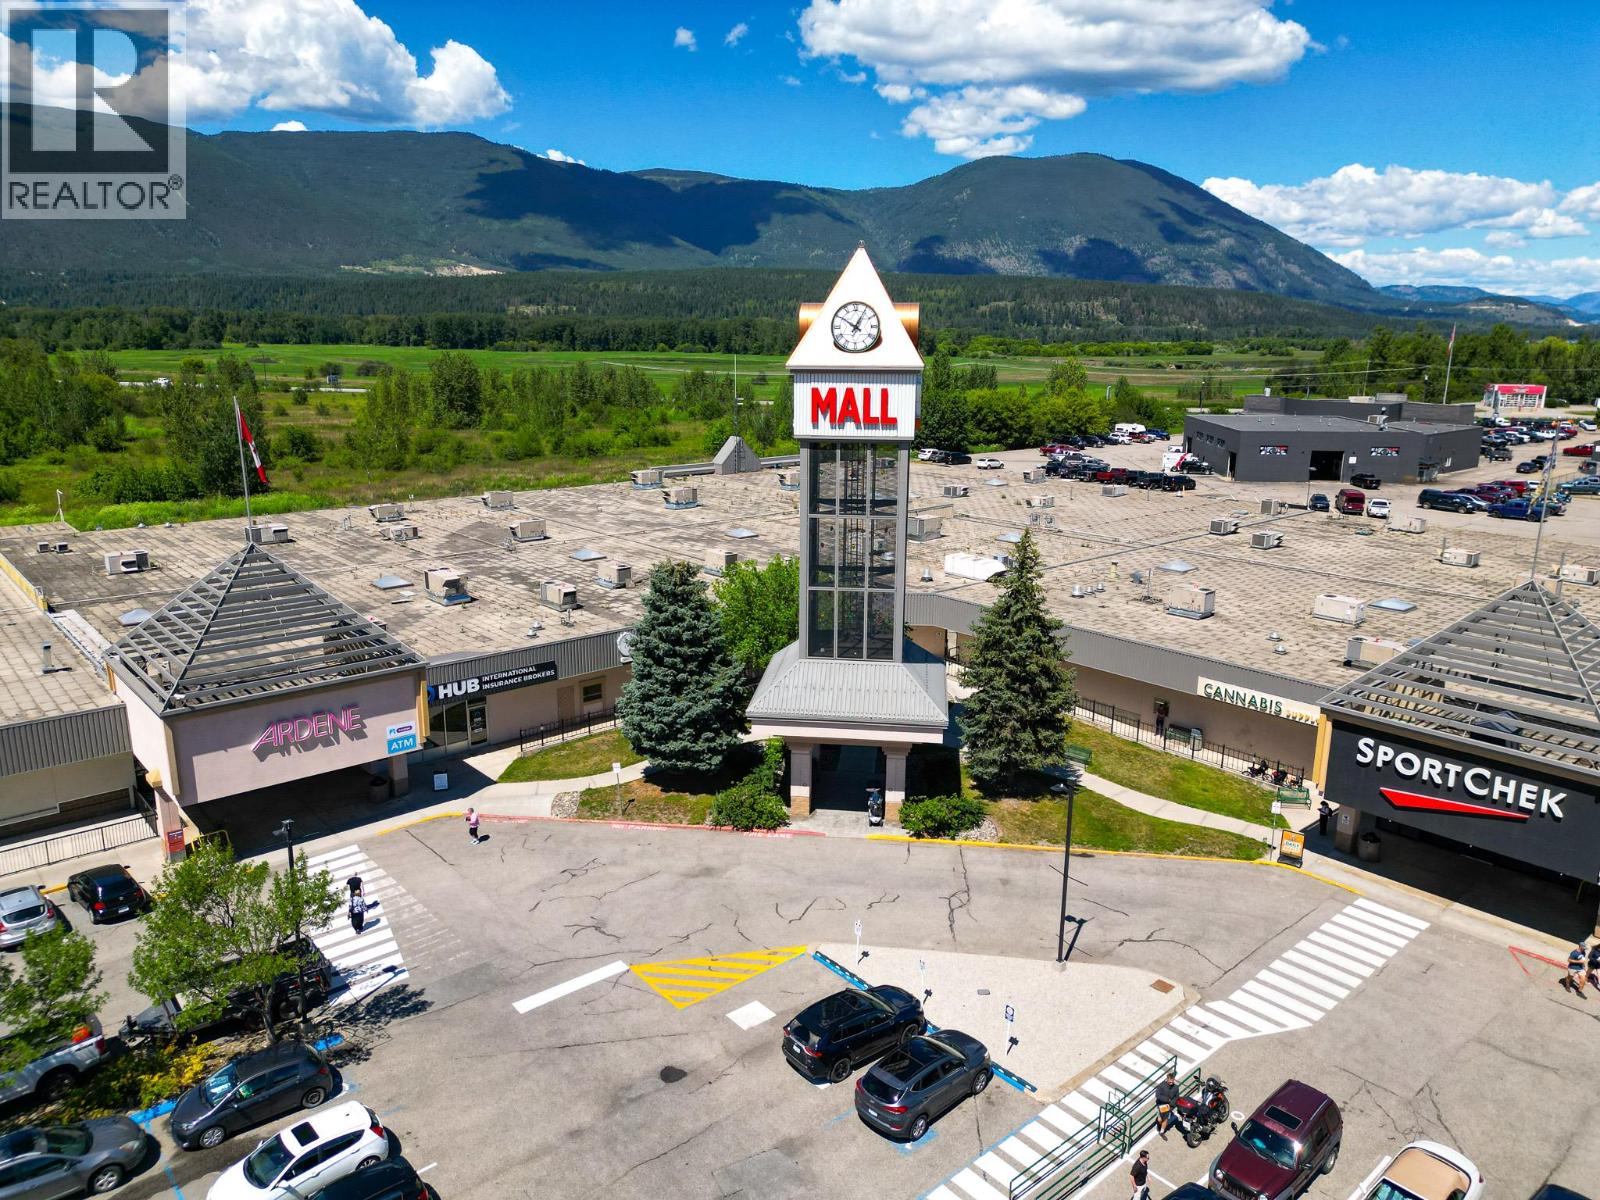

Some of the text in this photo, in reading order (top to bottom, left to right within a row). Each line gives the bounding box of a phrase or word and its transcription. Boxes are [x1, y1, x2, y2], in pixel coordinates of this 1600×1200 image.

[811, 387, 898, 426] MALL
[482, 666, 536, 682] INTERNATIONAL
[482, 669, 555, 690] INSURANCE BROKERS
[438, 678, 481, 700] HUB
[1203, 683, 1284, 715] CANNABIS
[252, 704, 364, 754] ARDENE
[391, 738, 414, 751] ATM
[1356, 737, 1568, 820] SPORTCHEK
